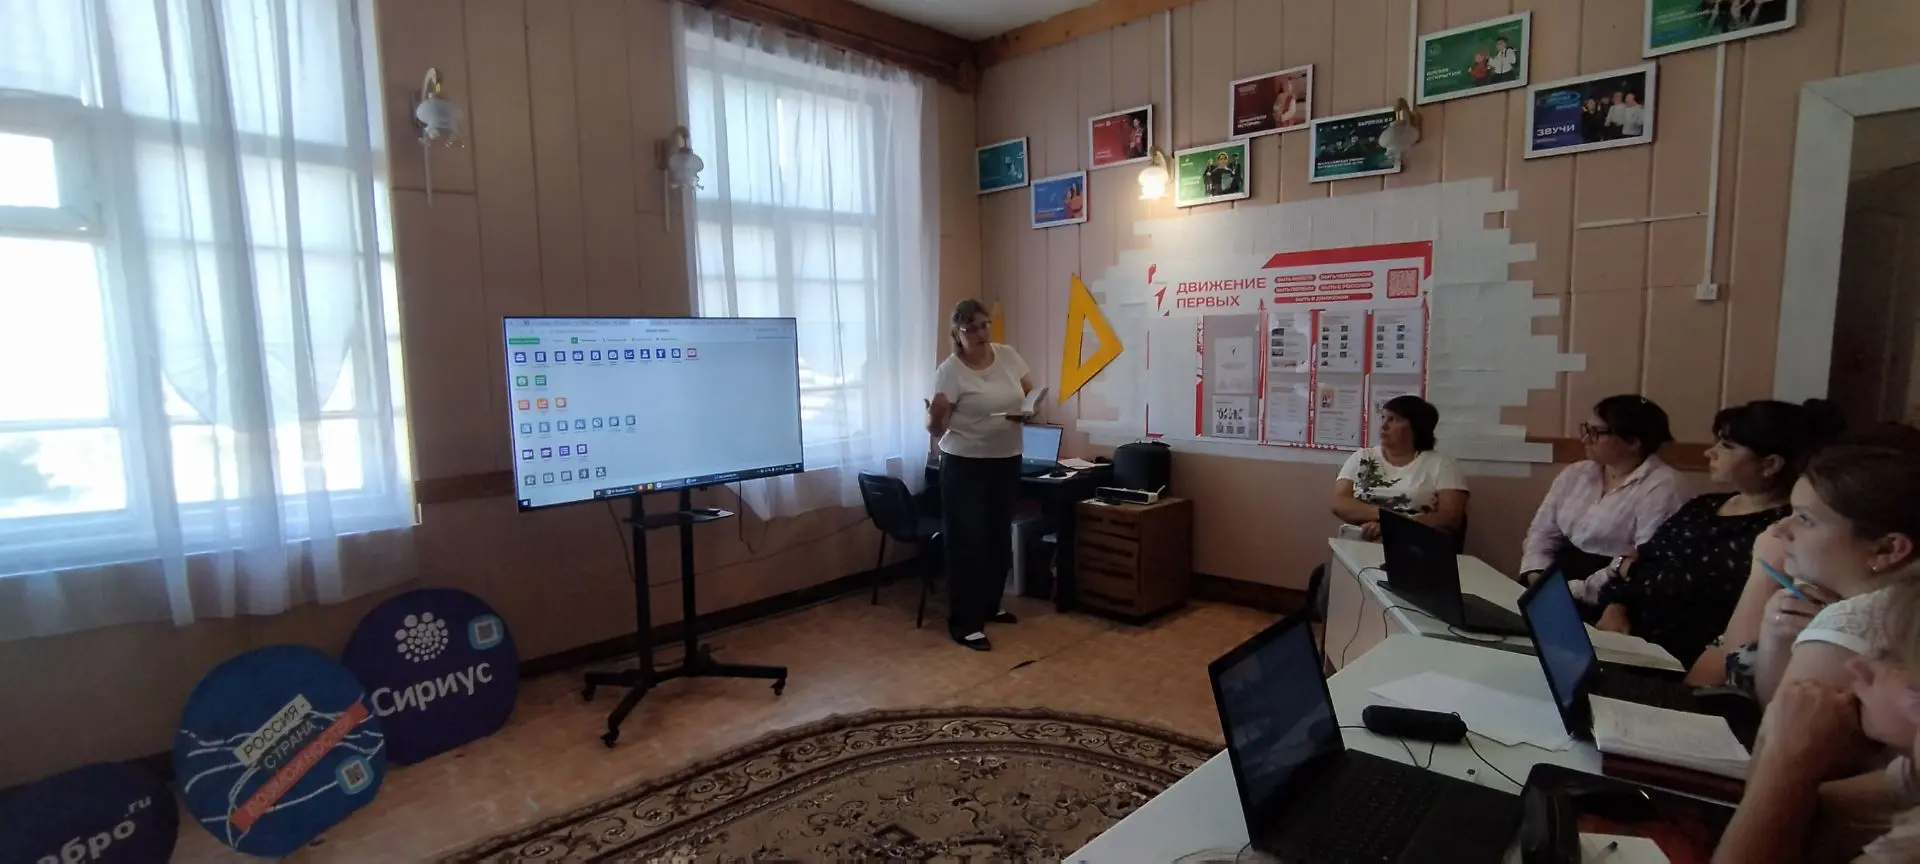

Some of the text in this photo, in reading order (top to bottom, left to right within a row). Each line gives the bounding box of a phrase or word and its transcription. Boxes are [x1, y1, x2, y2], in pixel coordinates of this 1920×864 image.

[1536, 123, 1575, 137] ЗВУЧИ
[1176, 277, 1267, 295] ДВИЖЕНИЕ
[1176, 295, 1240, 309] ПЕРВЫХ
[370, 660, 494, 718] Сириус
[243, 704, 300, 759] РОССИЯ
[264, 720, 317, 770] СТРАНА
[36, 819, 137, 864] бро
